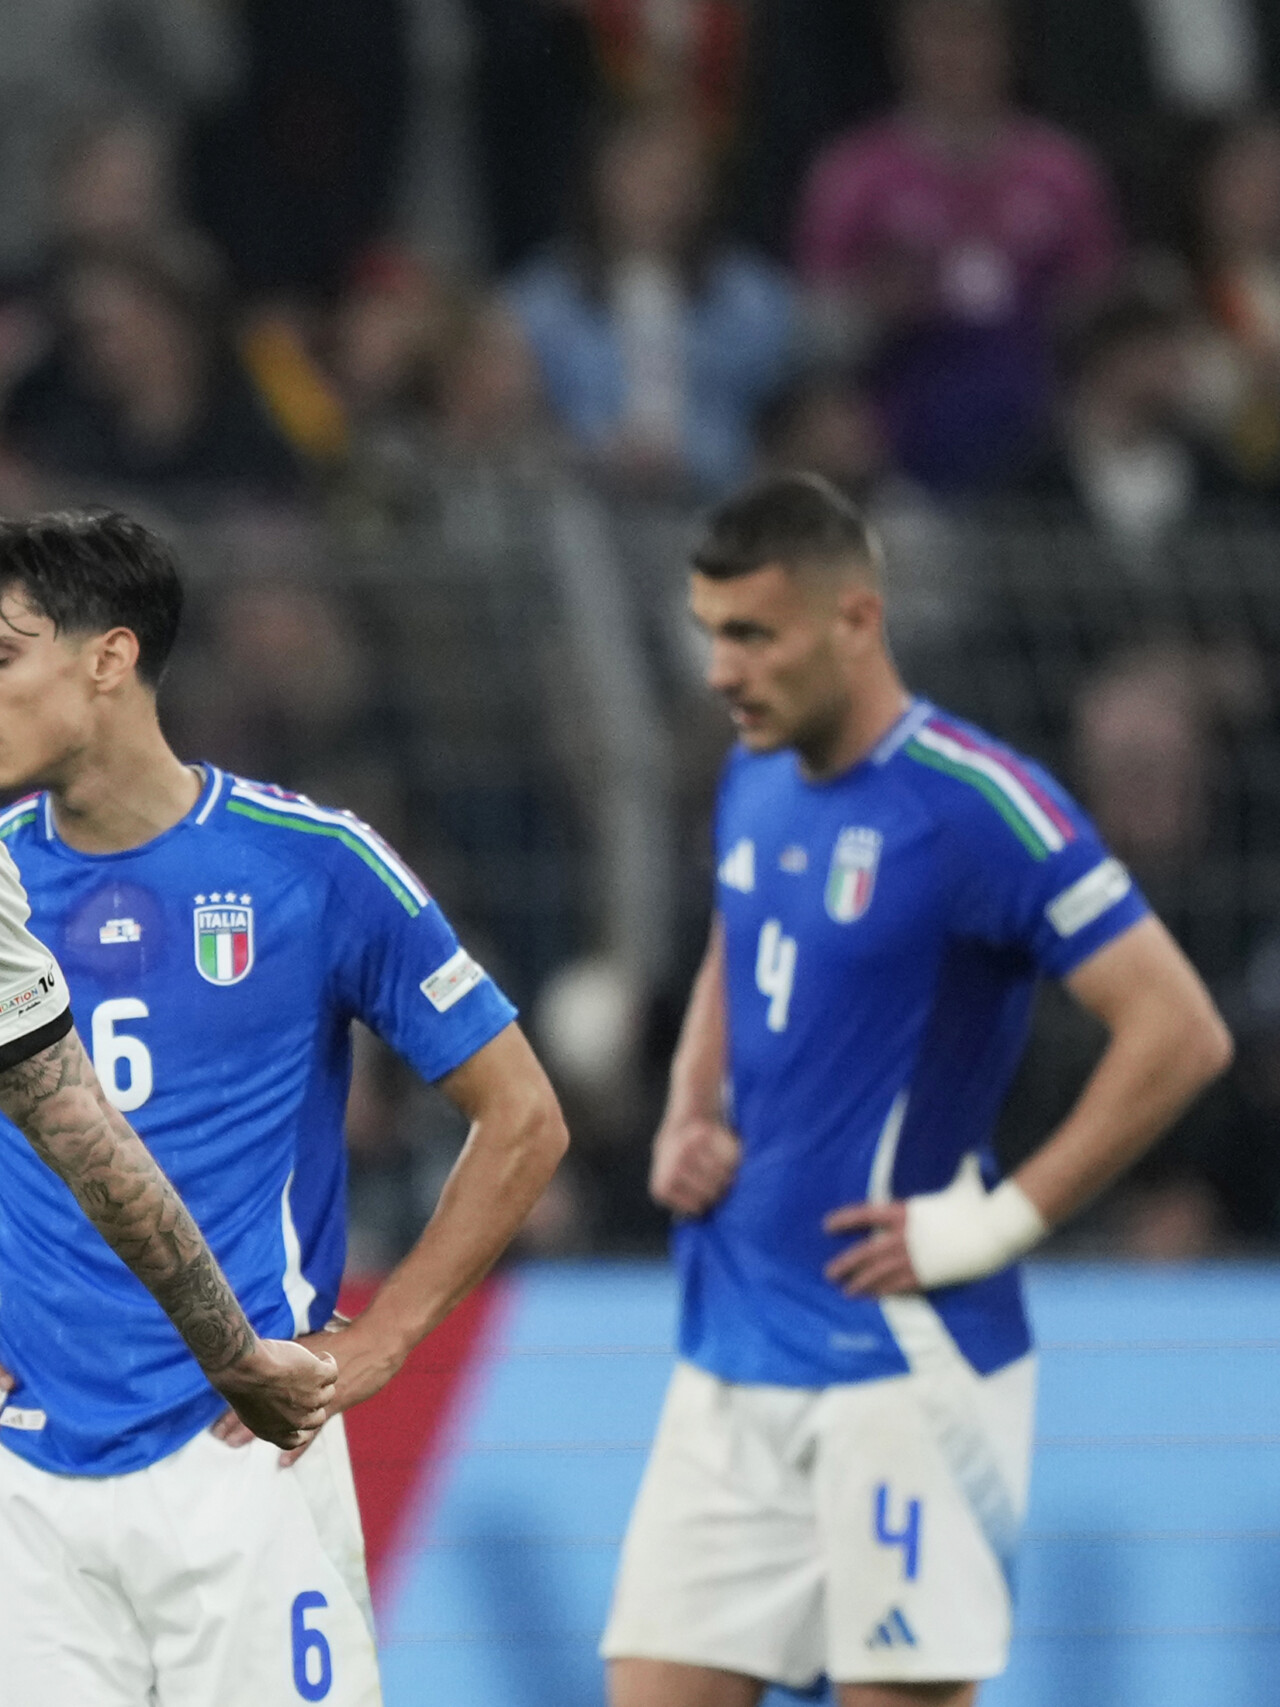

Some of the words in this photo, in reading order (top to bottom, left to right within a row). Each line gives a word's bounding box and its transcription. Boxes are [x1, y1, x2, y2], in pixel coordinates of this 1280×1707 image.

[199, 911, 247, 928] ITALIA
[755, 918, 798, 1033] 4
[91, 997, 153, 1113] 6
[875, 1482, 922, 1582] 4
[291, 1590, 332, 1703] 6
